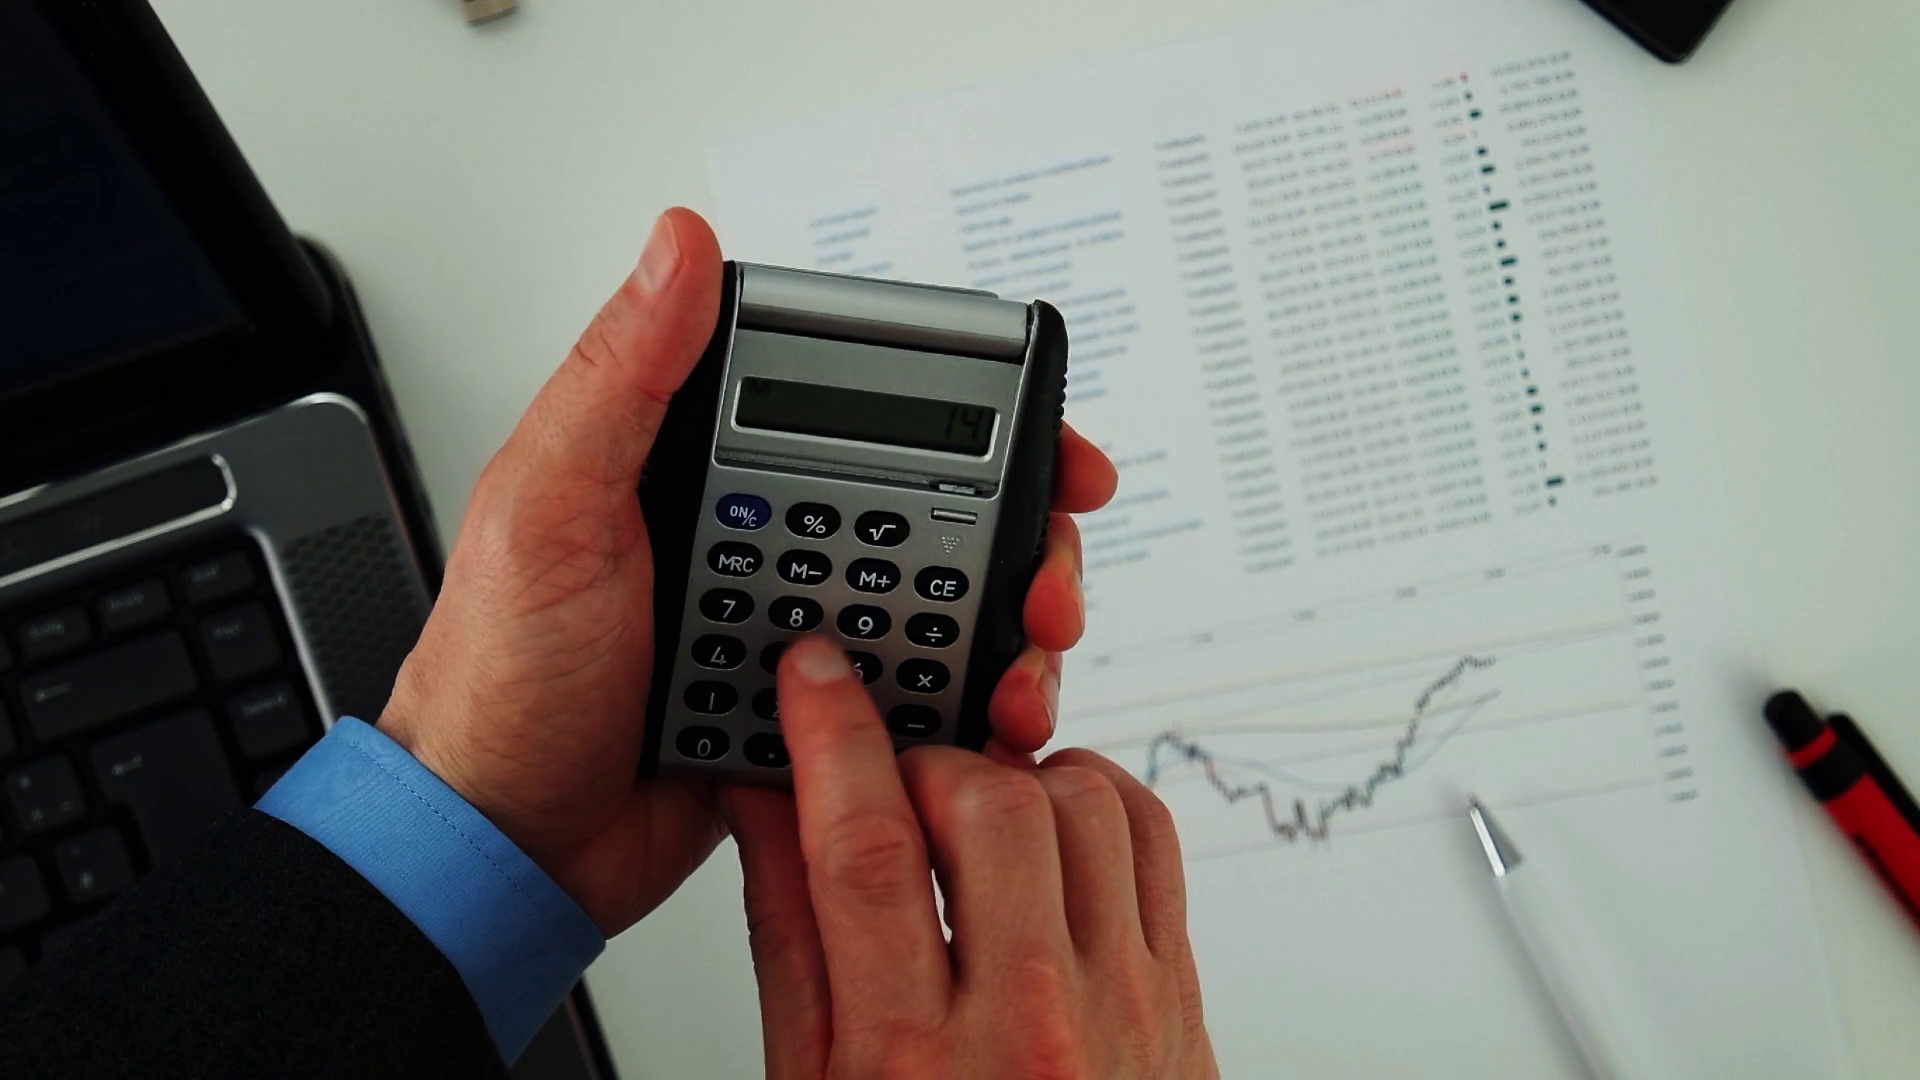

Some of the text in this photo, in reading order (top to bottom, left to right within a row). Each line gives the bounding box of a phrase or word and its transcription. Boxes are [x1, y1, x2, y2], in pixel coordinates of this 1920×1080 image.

[803, 515, 826, 534] %
[718, 554, 754, 573] MRC
[858, 570, 891, 588] M+
[929, 579, 957, 597] CE
[722, 599, 736, 619] 7
[789, 607, 804, 627] 8
[857, 616, 874, 635] 9
[710, 646, 727, 666] 4
[697, 738, 711, 757] 0
